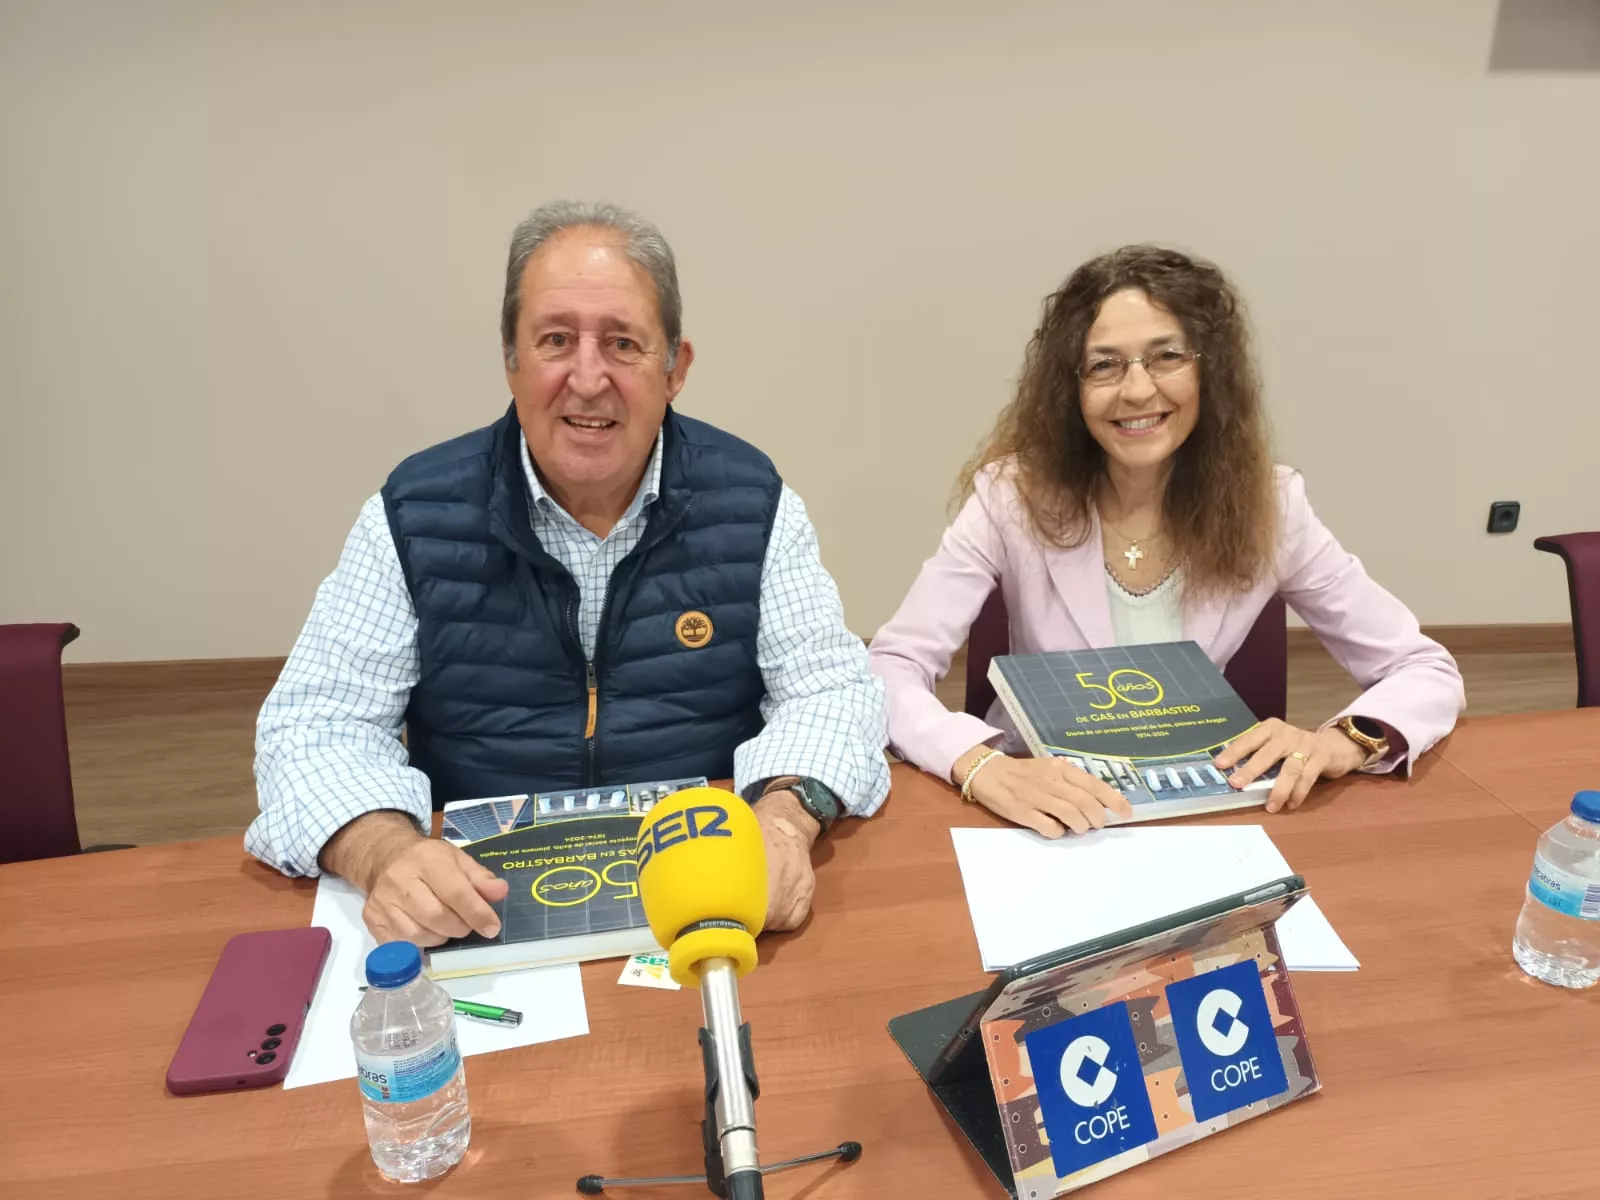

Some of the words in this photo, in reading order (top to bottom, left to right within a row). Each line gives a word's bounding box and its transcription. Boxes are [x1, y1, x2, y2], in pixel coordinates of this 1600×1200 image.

[1075, 668, 1164, 709] 50
[1116, 680, 1155, 692] años
[1090, 712, 1116, 721] GAS
[1129, 705, 1200, 718] BARBASTRO
[617, 847, 638, 857] AS
[637, 805, 732, 876] SER
[502, 852, 597, 870] BARBASTRO
[531, 860, 638, 907] 50
[539, 878, 594, 894] años
[1211, 1057, 1262, 1092] COPE
[1074, 1106, 1130, 1145] COPE
